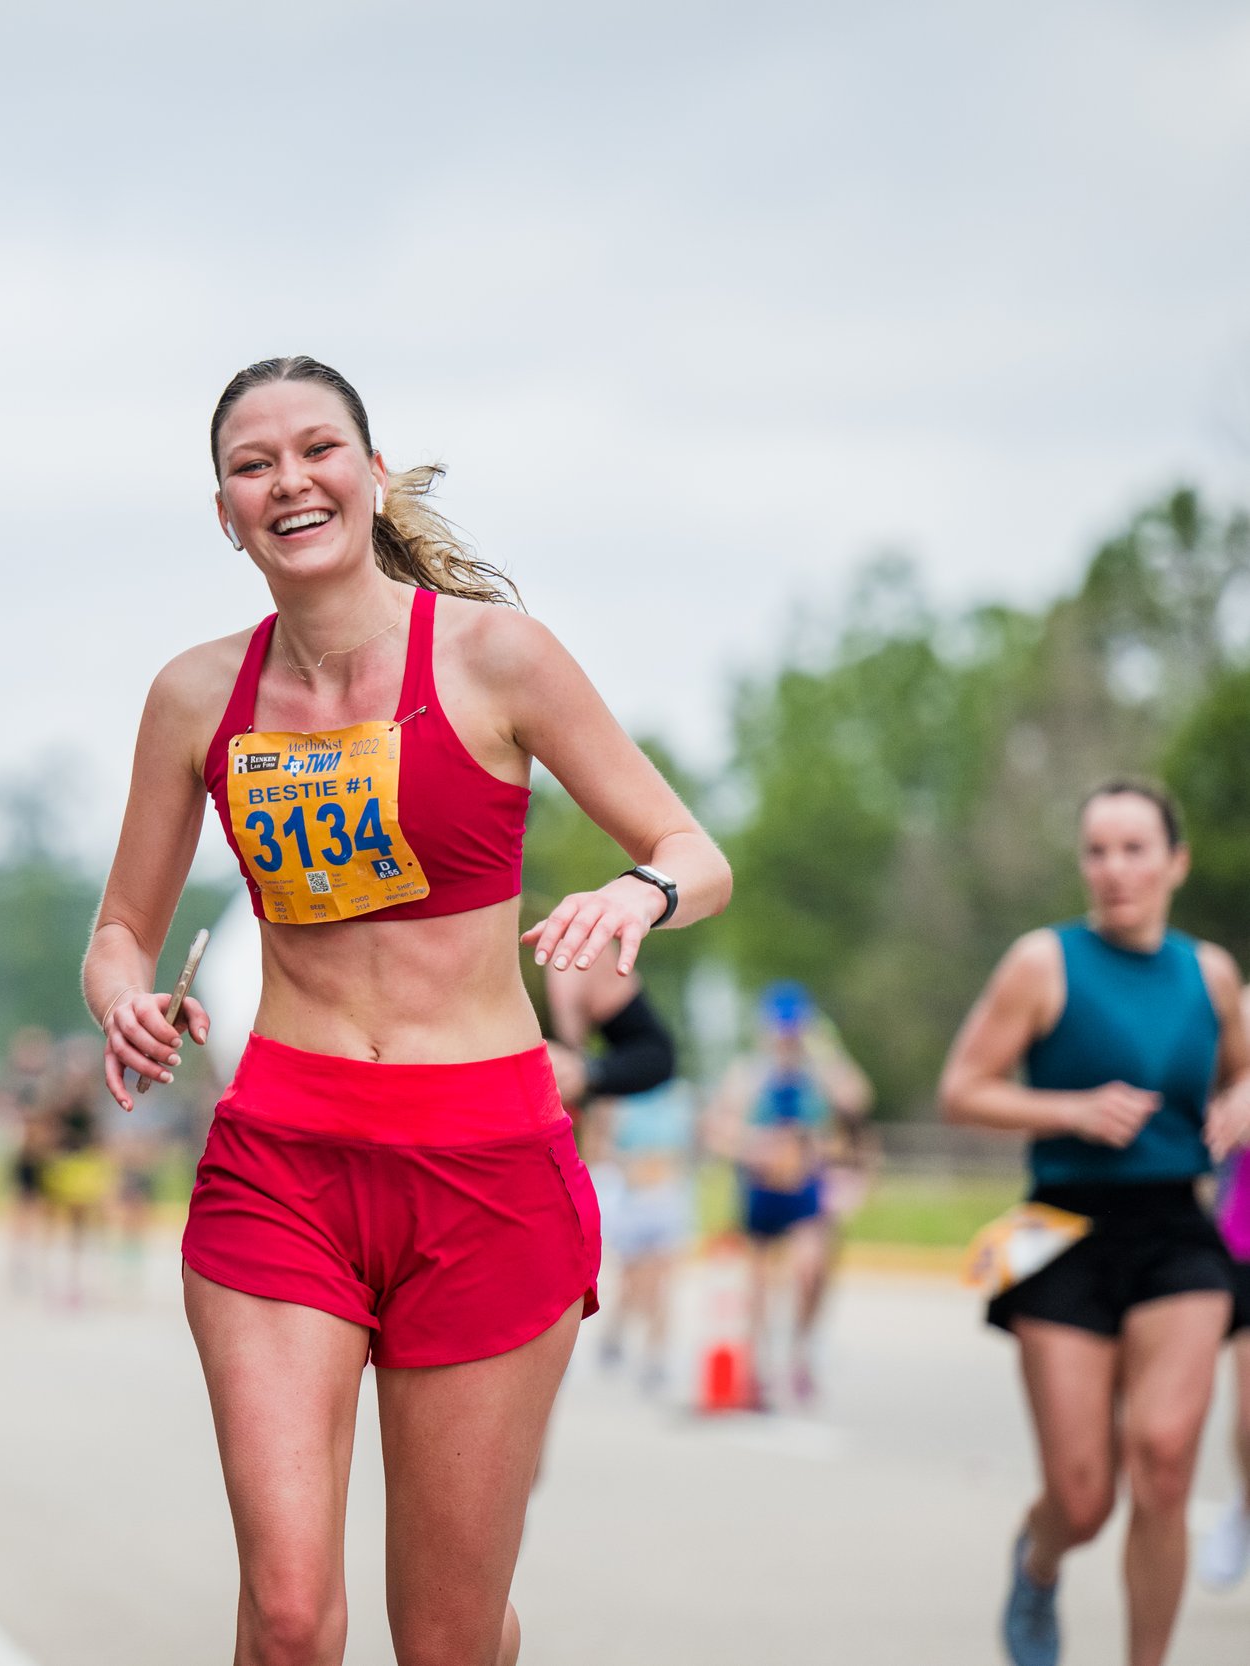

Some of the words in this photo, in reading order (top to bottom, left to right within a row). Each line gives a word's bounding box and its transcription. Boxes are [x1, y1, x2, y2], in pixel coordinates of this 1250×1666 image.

[350, 738, 379, 757] 2022
[233, 754, 248, 775] R
[305, 751, 343, 774] TWM
[248, 779, 338, 805] BESTIE
[346, 776, 373, 794] #1
[245, 797, 393, 873] 3134
[379, 861, 391, 871] D
[379, 868, 400, 879] 6:55
